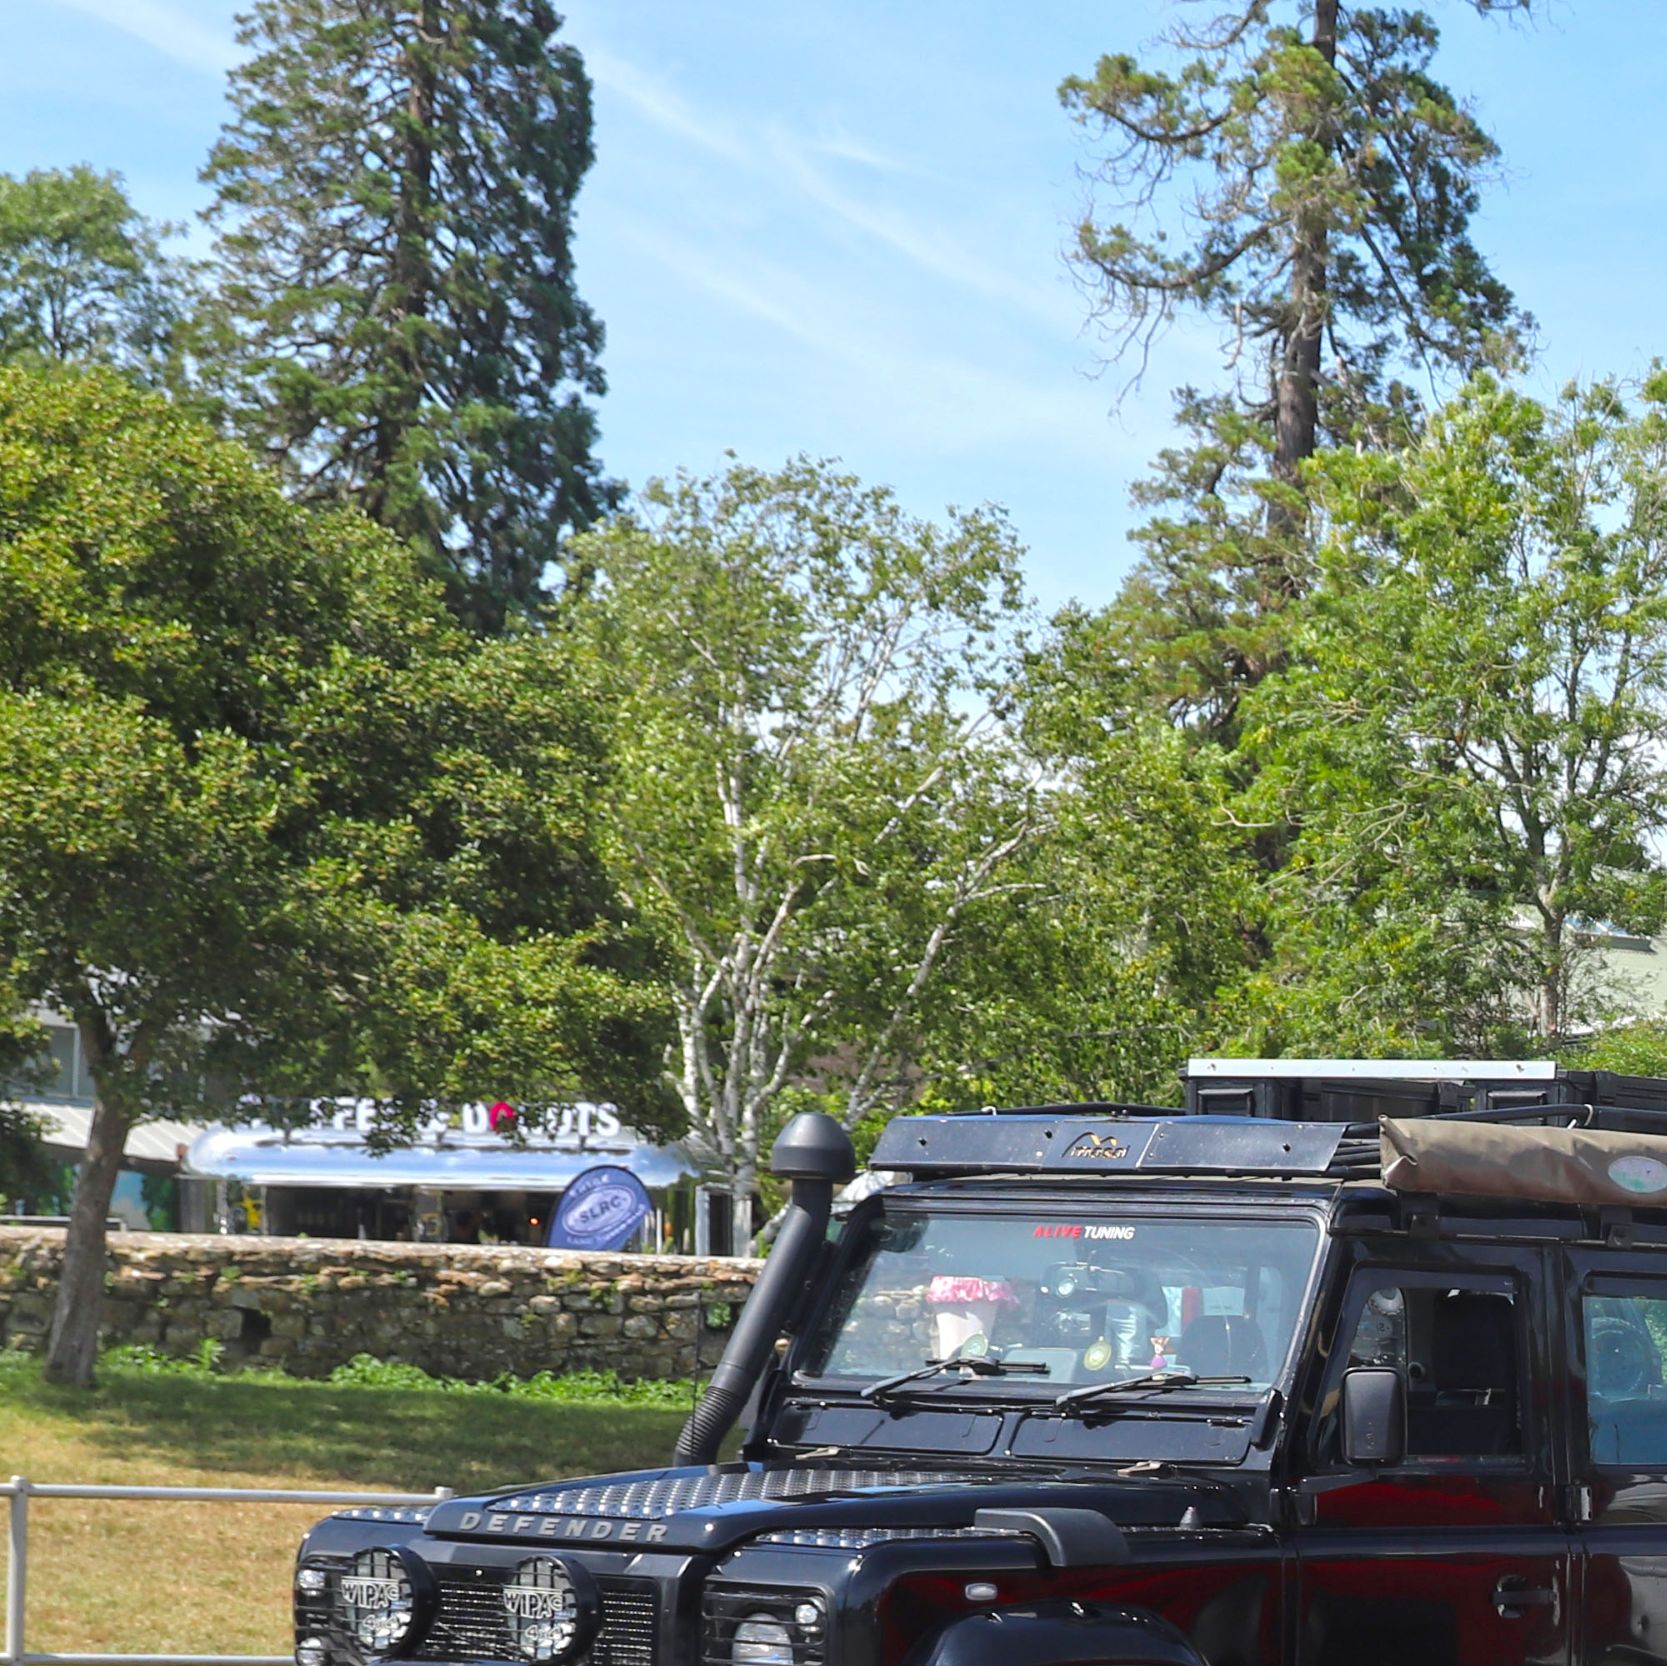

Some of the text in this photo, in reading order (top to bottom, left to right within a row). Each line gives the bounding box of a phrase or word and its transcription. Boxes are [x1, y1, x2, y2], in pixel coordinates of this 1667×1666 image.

[462, 1101, 621, 1137] DOUTS
[1033, 1224, 1136, 1240] ALIVE TUNING
[459, 1511, 669, 1543] DEFENDER
[341, 1579, 399, 1609] WIPAC
[503, 1588, 563, 1619] WIPAC
